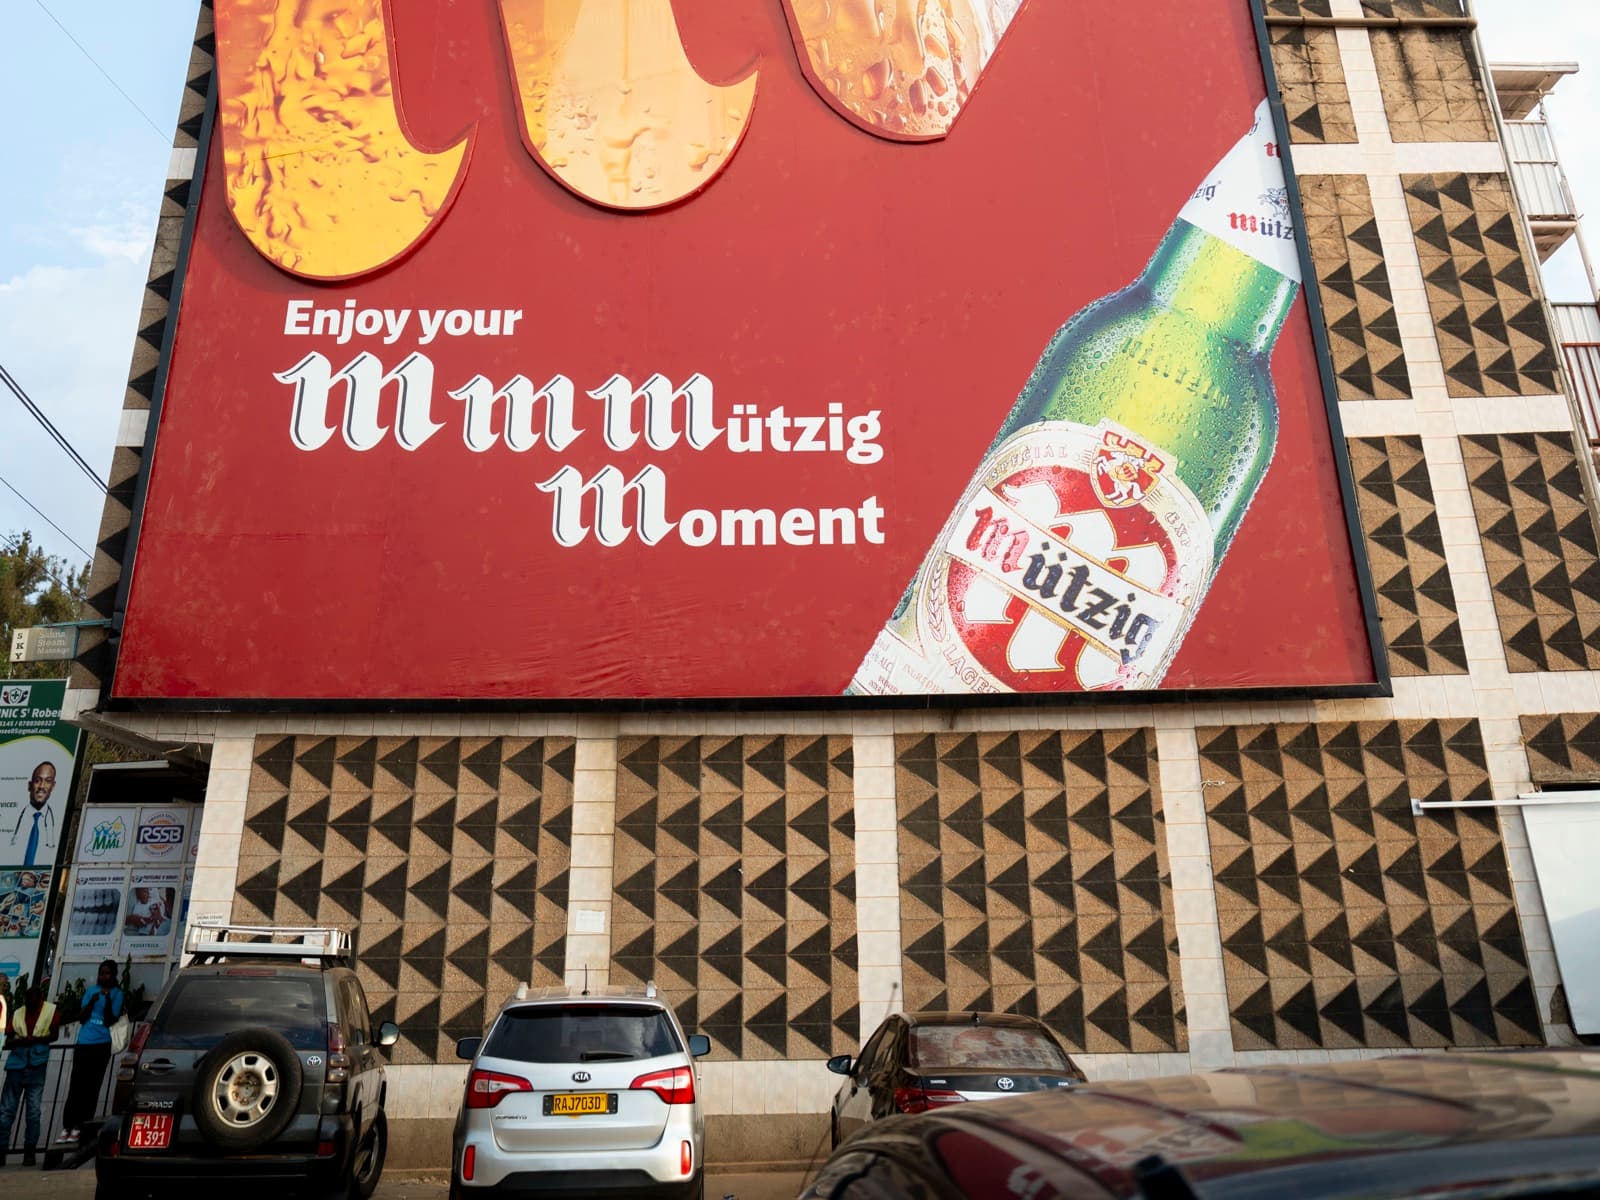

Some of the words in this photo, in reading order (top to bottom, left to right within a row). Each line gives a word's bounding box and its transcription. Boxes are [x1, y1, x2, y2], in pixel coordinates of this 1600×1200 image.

[283, 299, 412, 345] Enjoy
[417, 305, 523, 345] your
[15, 632, 24, 660] SKY
[0, 708, 19, 718] NIC
[140, 827, 181, 843] RSSB
[574, 1072, 589, 1081] KIA
[554, 1096, 601, 1111] RAJ703D
[134, 1131, 142, 1146] A
[144, 1131, 166, 1146] 391
